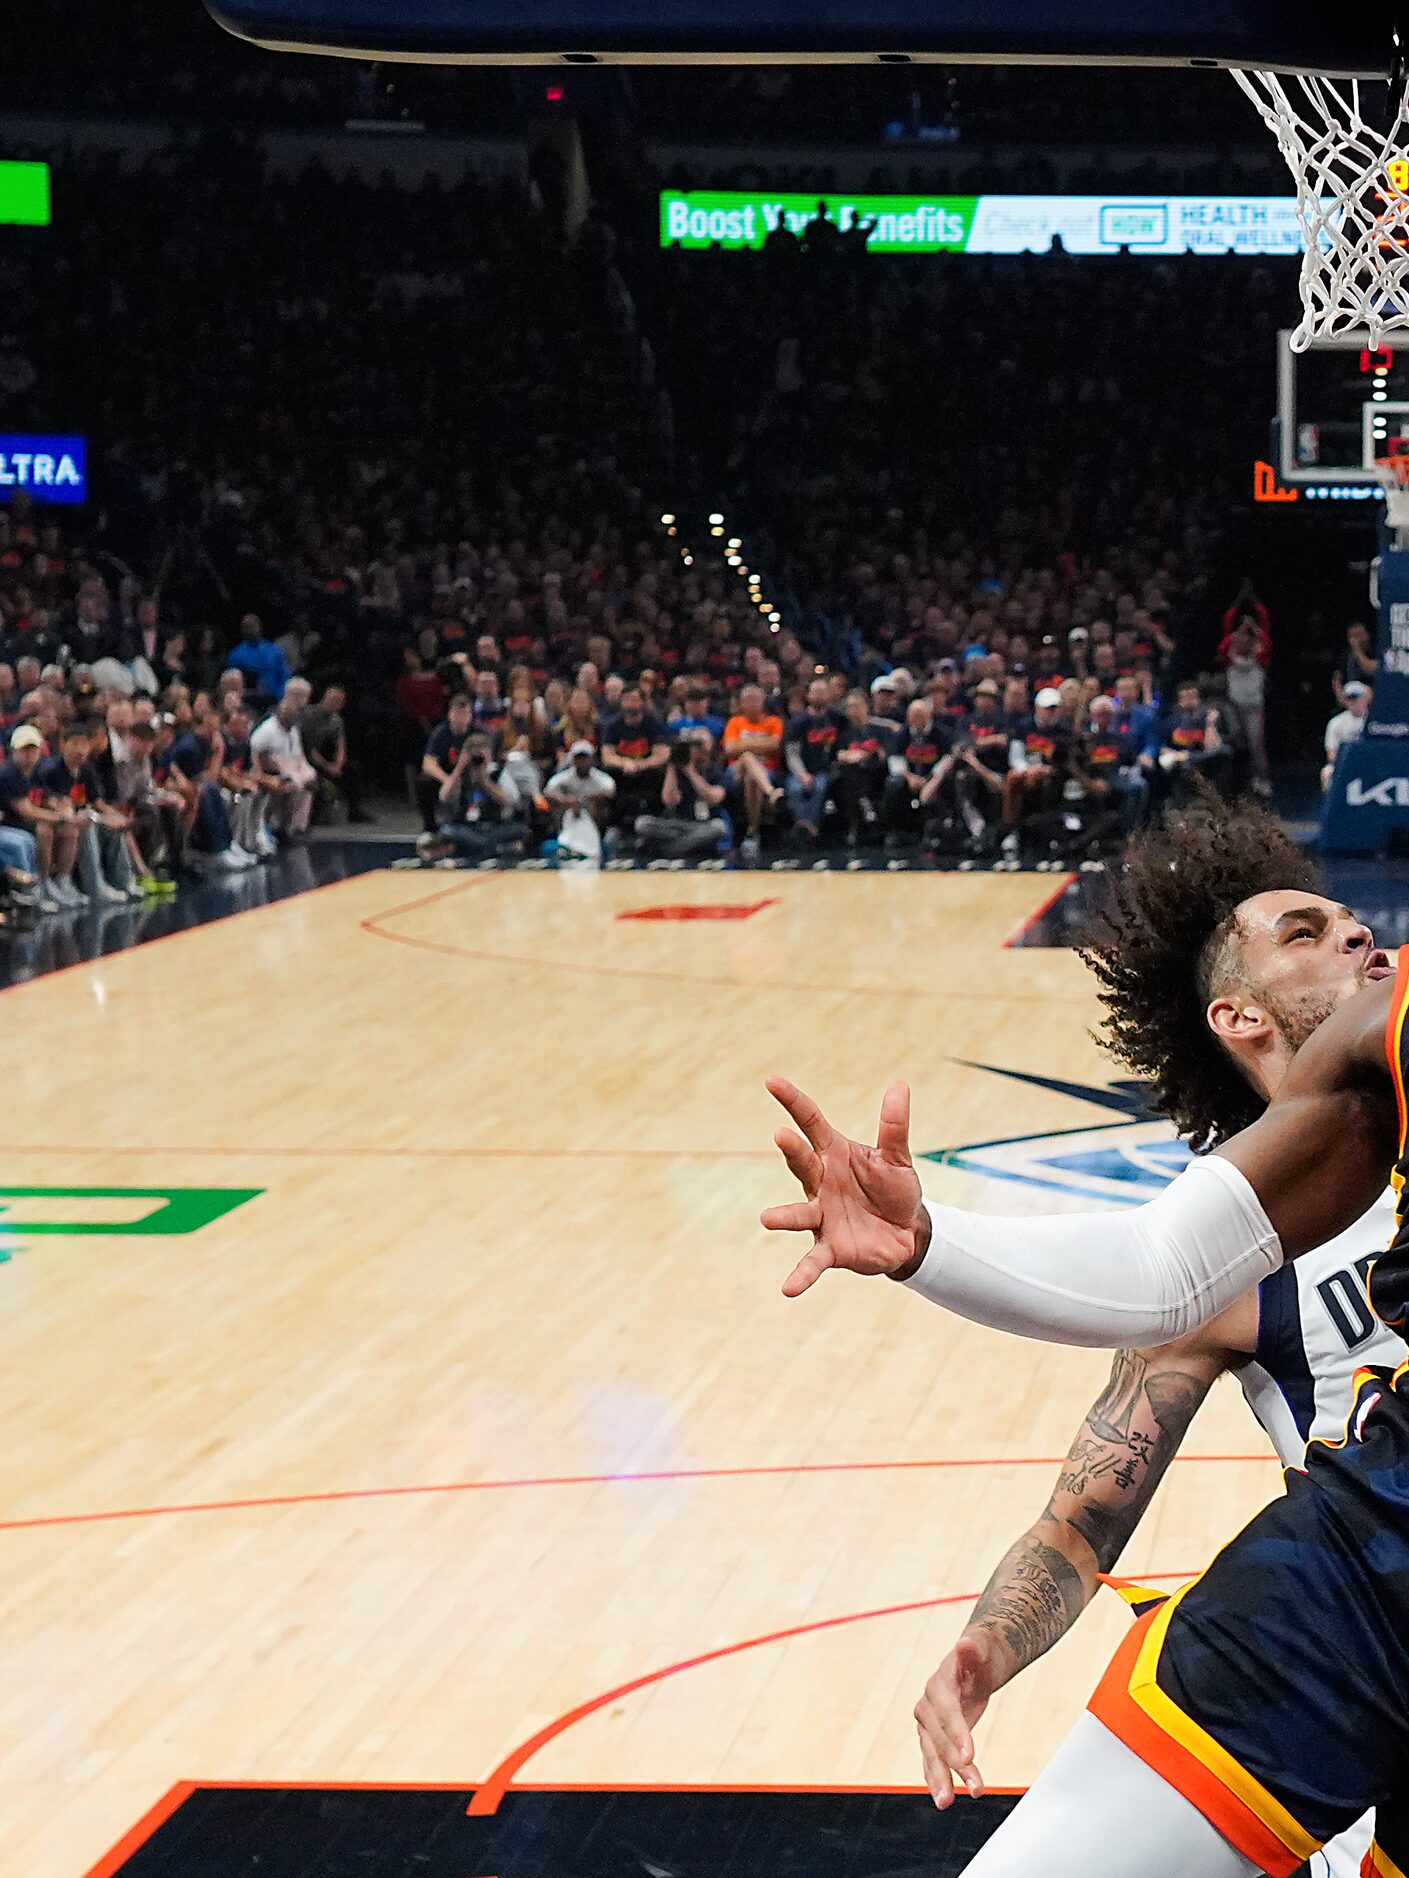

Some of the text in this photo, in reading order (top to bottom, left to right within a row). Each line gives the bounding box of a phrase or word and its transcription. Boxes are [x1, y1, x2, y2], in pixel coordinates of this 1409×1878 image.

[667, 200, 756, 241] Boost
[1180, 205, 1269, 225] HEALTH
[1314, 1250, 1390, 1354] D
